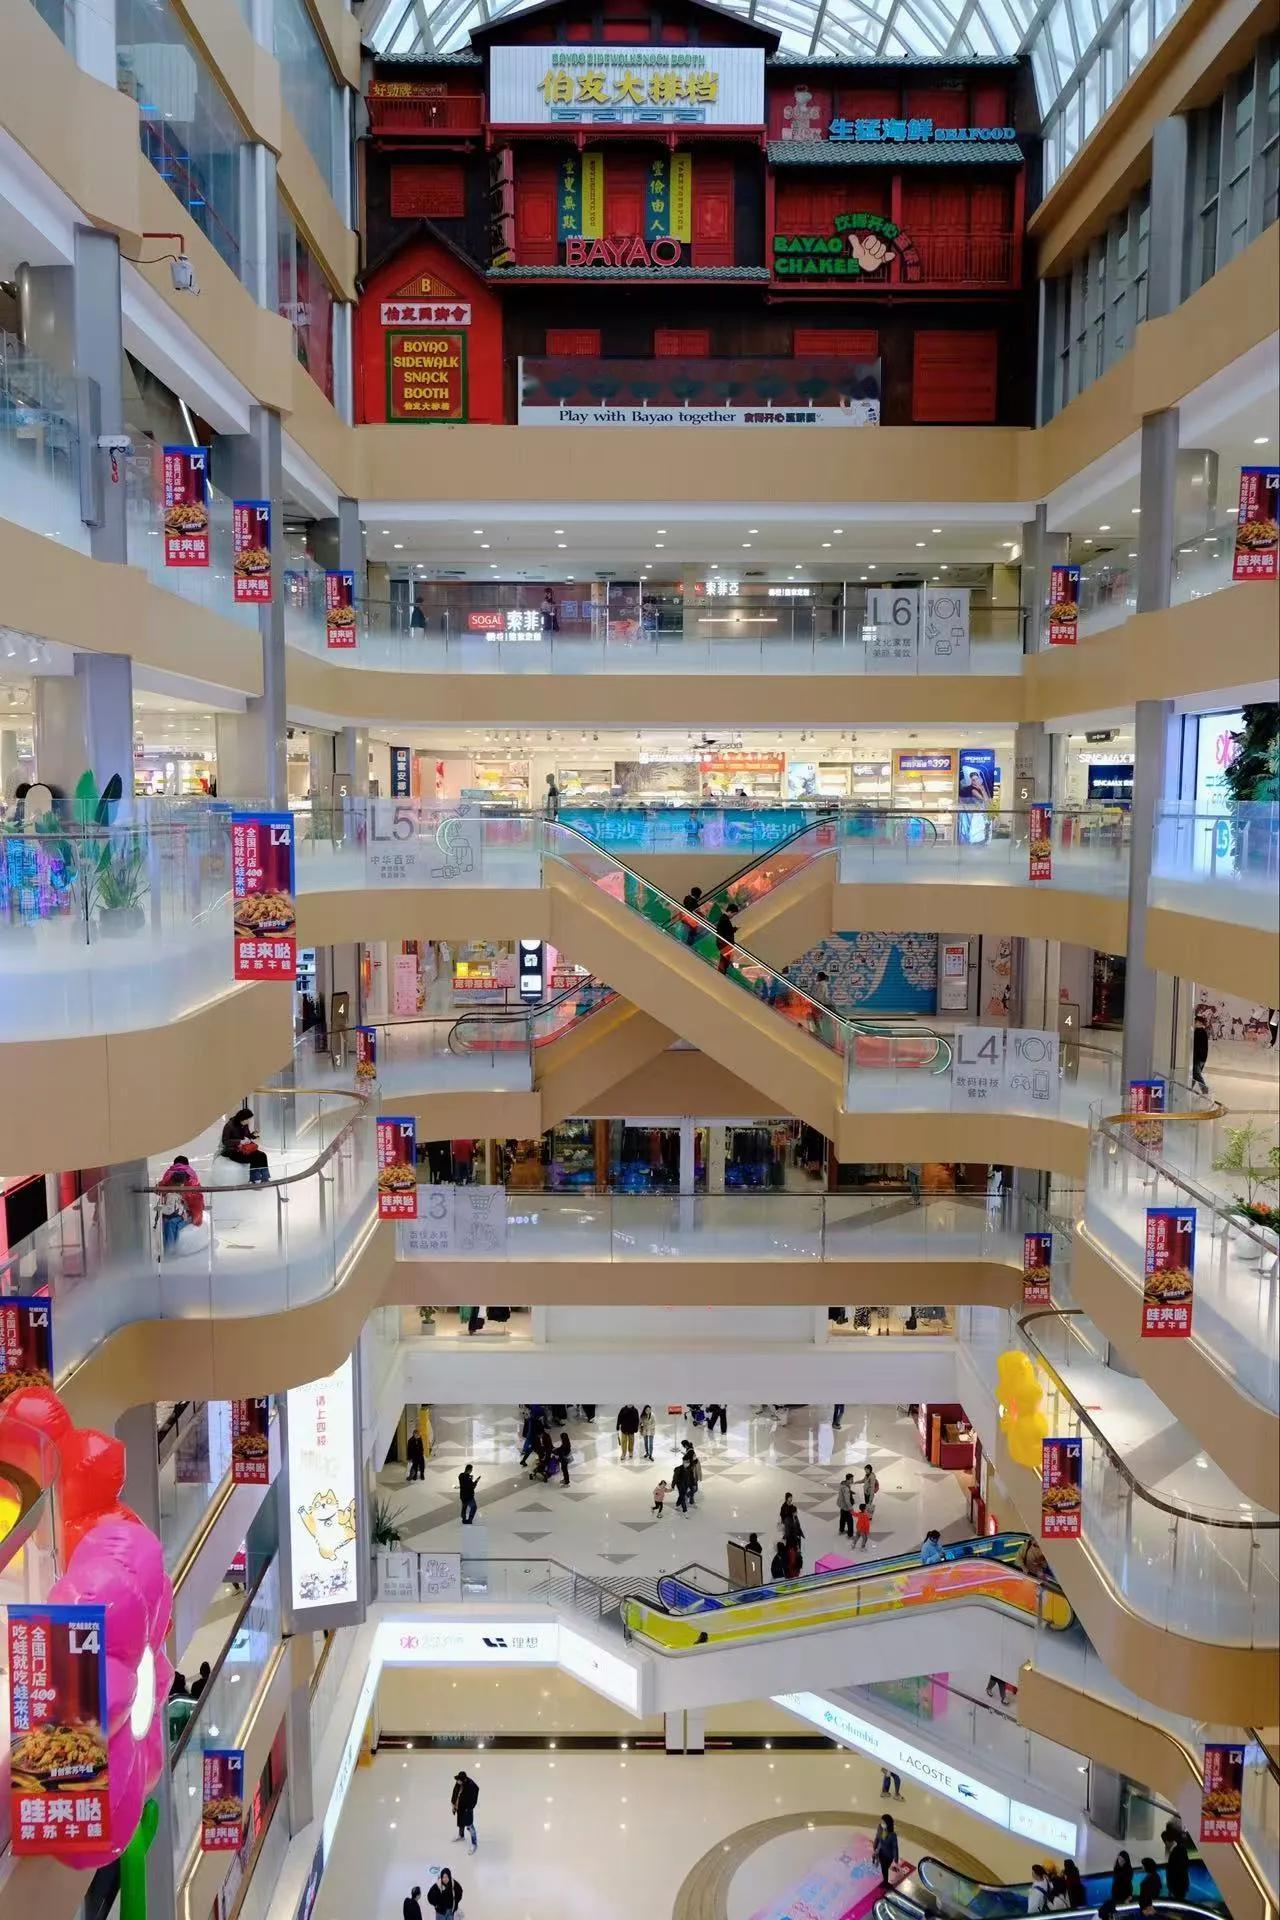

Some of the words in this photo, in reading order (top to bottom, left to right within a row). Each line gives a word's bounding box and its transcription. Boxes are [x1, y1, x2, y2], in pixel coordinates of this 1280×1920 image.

[935, 128, 1015, 141] SEAFOOD
[774, 237, 842, 252] BAYAO
[566, 237, 681, 266] BAYAO
[421, 279, 431, 292] B
[394, 356, 459, 369] SIDEWALK
[404, 371, 449, 384] SNACK
[404, 388, 449, 399] BOOTH
[559, 410, 589, 424] Play
[593, 410, 626, 422] with
[631, 410, 674, 424] Bayao
[678, 410, 736, 424] together
[190, 458, 205, 470] L4
[1265, 478, 1280, 489] L4
[256, 510, 269, 521] L4
[1069, 573, 1079, 581] L4
[873, 597, 911, 625] L6
[507, 610, 544, 630] 索菲
[339, 785, 347, 797] 5
[1021, 788, 1028, 799] 5
[371, 805, 415, 841] L5
[270, 829, 291, 846] L4
[338, 1003, 345, 1015] 4
[1064, 1016, 1072, 1026] 4
[957, 1034, 999, 1065] L4
[400, 1126, 413, 1137] L4
[1176, 1220, 1193, 1233] L4
[29, 1312, 48, 1328] L4
[1066, 1447, 1080, 1458] L4
[385, 1558, 411, 1578] L1
[69, 1629, 101, 1655] L4
[12, 1625, 29, 1730] 吃蛙就吃蛙来哒
[30, 1626, 56, 1717] 全国门店400家
[227, 1760, 242, 1770] L4
[899, 1751, 953, 1787] LACOSTE
[20, 1798, 102, 1823] 蛙来哒
[21, 1824, 102, 1839] 紫苏牛蛙
